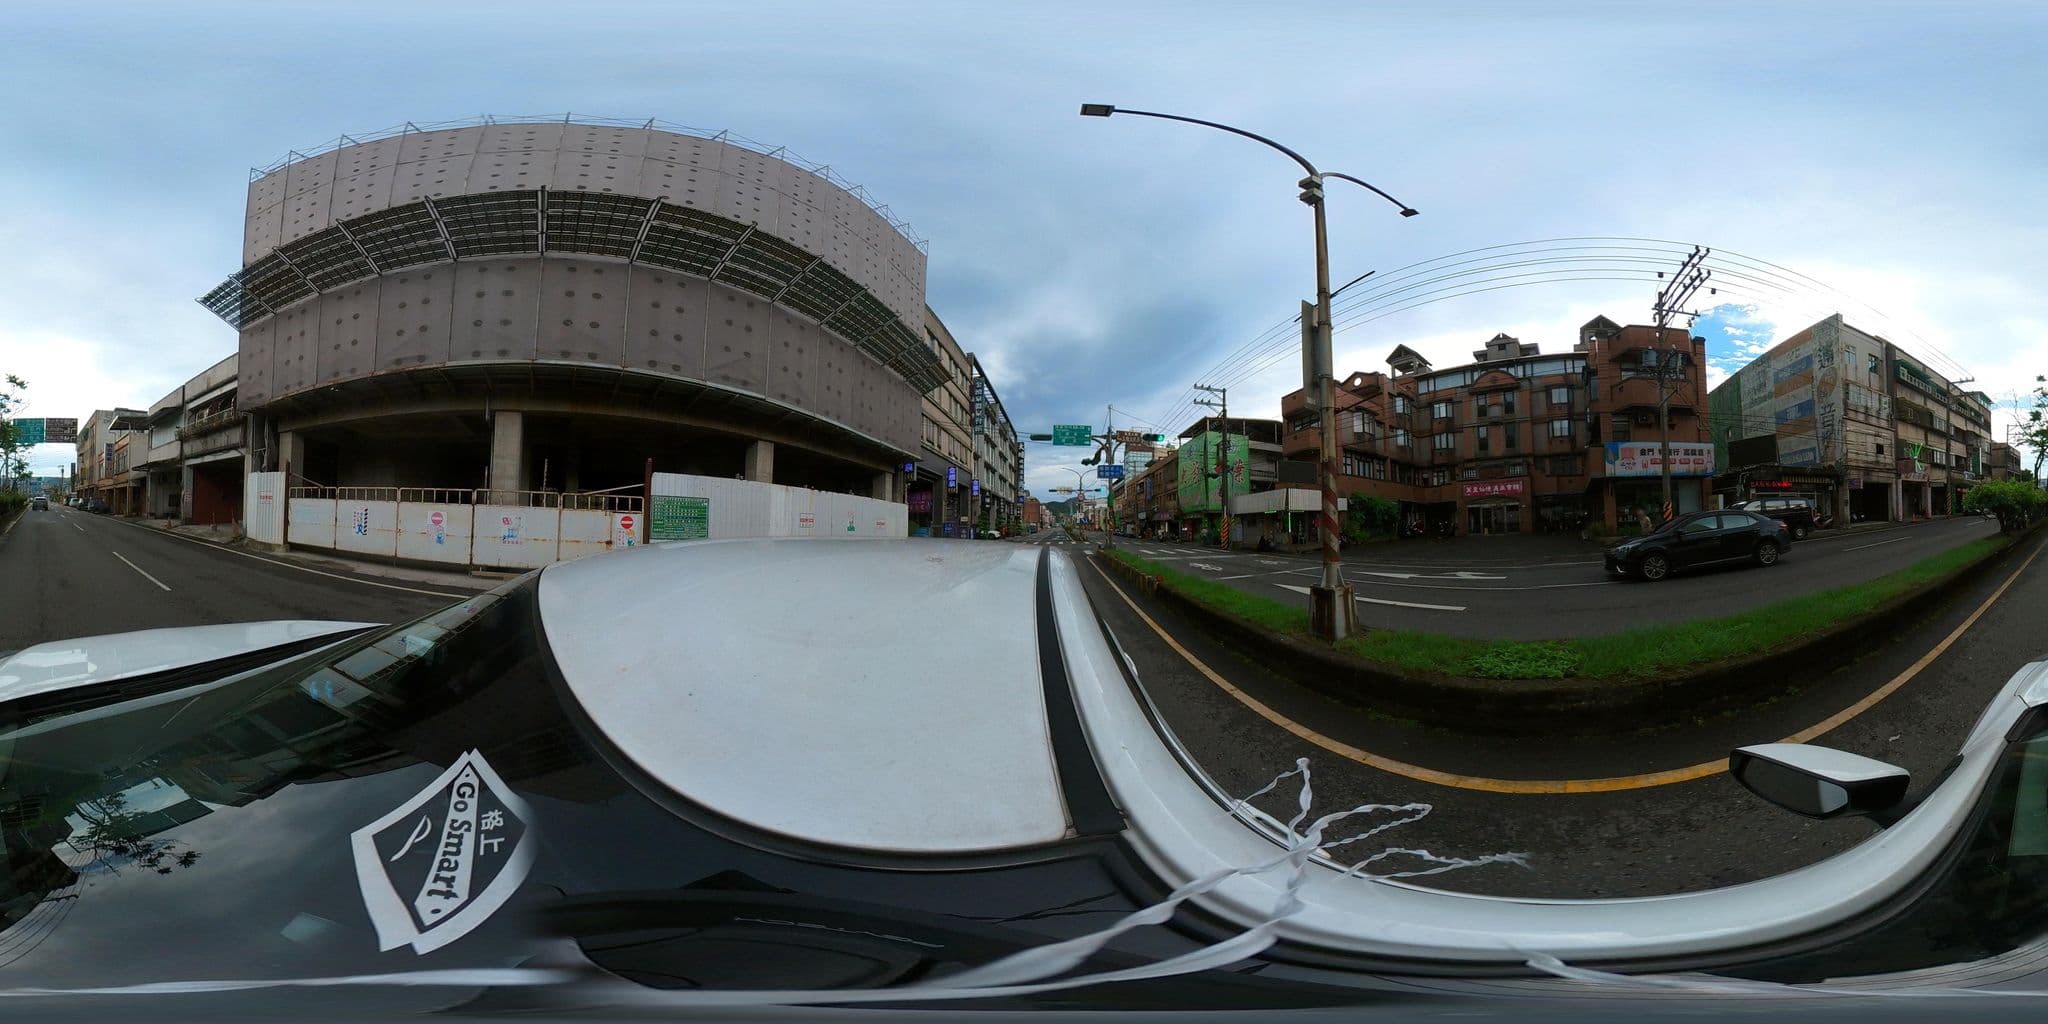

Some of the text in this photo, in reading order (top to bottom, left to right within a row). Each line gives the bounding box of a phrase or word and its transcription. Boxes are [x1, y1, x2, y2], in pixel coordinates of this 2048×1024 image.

[1639, 448, 1655, 457] 金門
[426, 782, 476, 900] Go Smart
[480, 809, 505, 856] 格上
